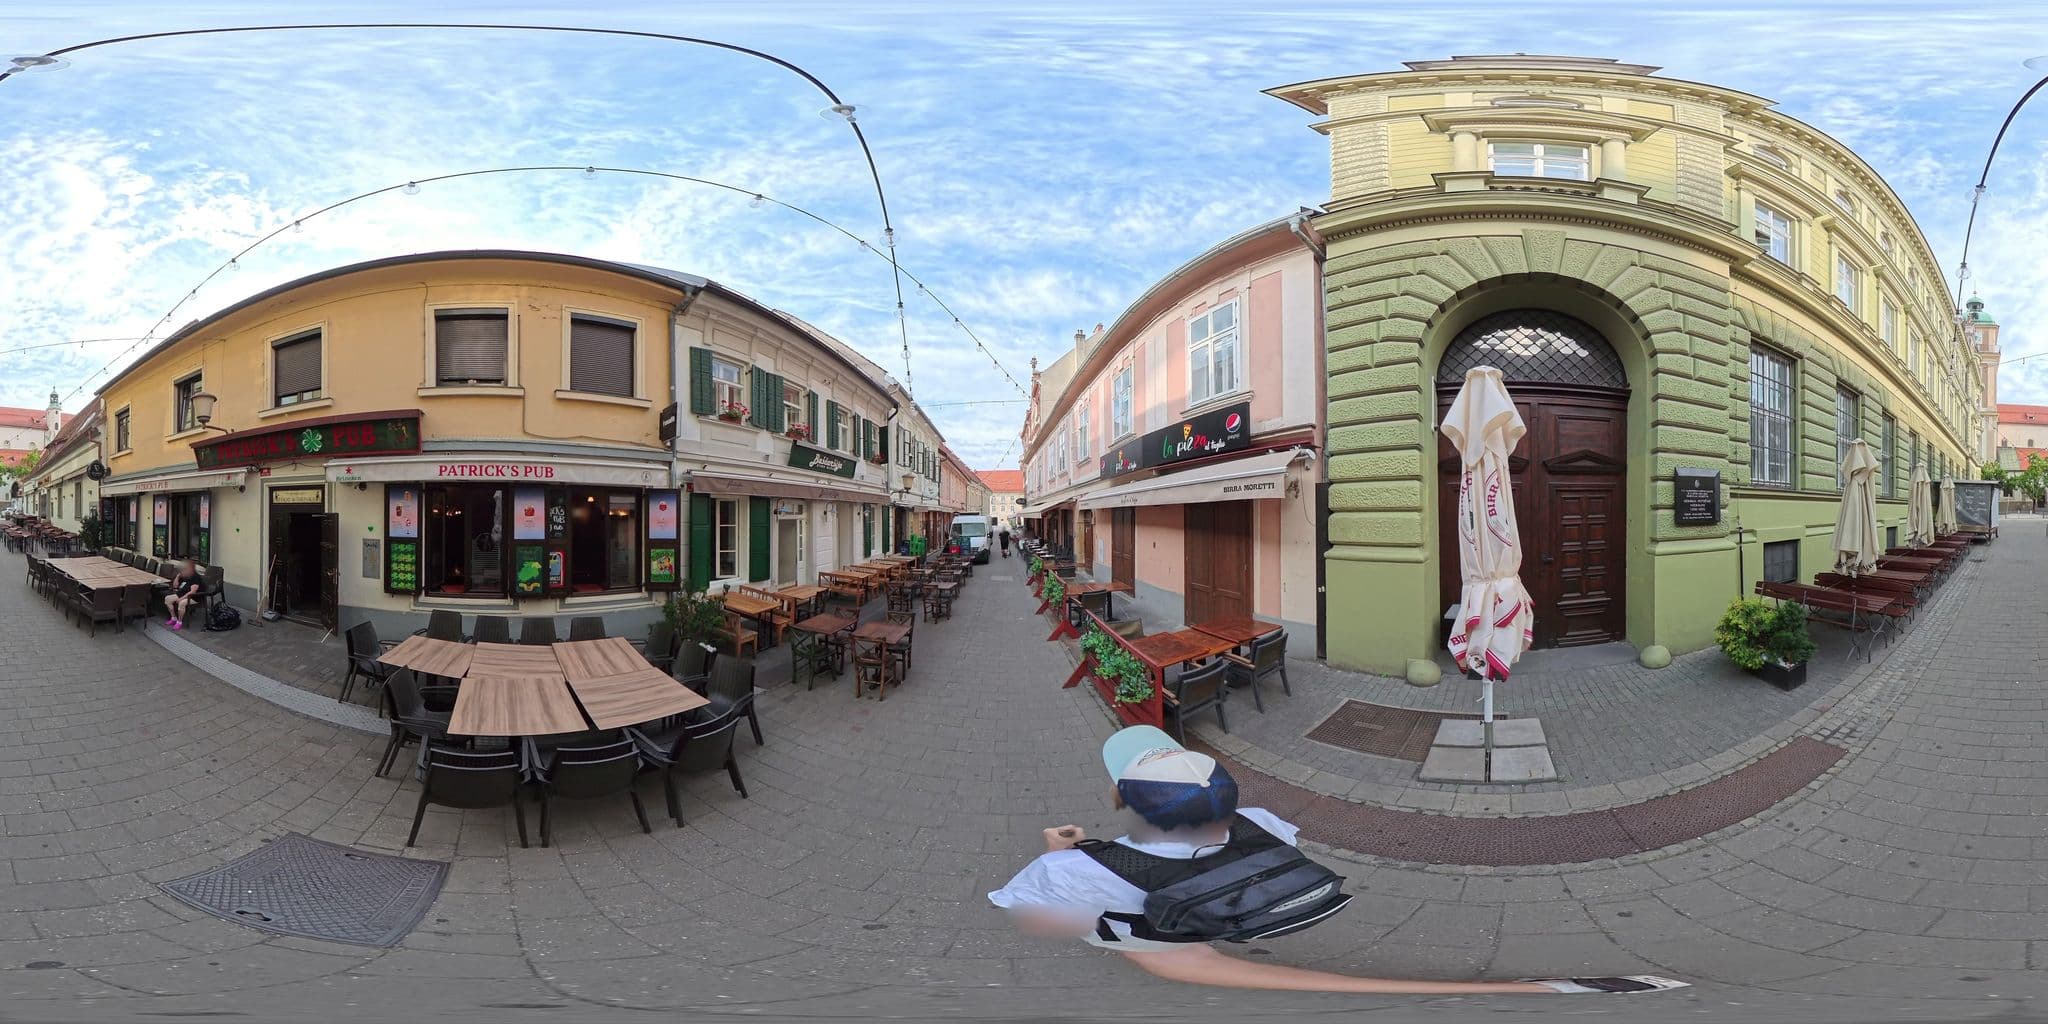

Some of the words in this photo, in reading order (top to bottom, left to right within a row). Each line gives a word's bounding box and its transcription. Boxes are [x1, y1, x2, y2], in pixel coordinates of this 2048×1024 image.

[332, 424, 376, 448] PUB
[438, 464, 519, 477] PATRICK'S
[523, 465, 554, 478] PUB
[1223, 485, 1242, 493] BIRRA
[1243, 482, 1275, 492] MORETTI
